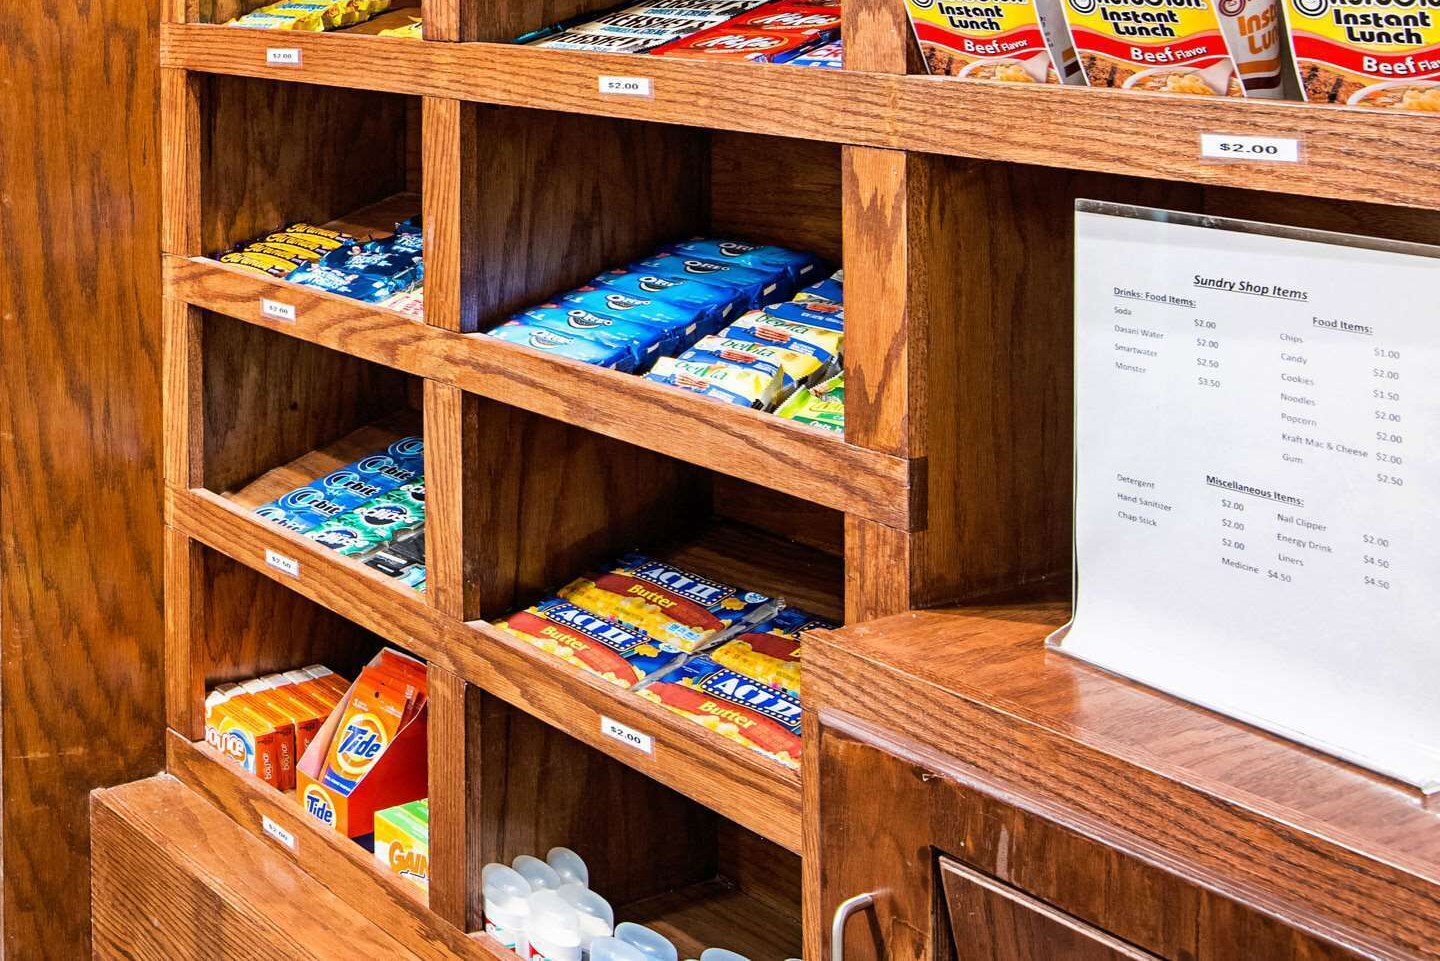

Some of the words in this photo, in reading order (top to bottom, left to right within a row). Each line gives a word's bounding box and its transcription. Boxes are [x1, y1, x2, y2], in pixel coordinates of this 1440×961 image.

[938, 3, 1003, 18] Instant
[1100, 6, 1179, 24] Instant
[1334, 8, 1431, 28] Instant
[949, 16, 1001, 31] Lunch
[1113, 22, 1175, 39] Lunch
[1346, 26, 1423, 44] Lunch
[963, 38, 1000, 54] Beef
[1000, 38, 1028, 52] Flavor
[1130, 46, 1174, 64] Beef
[1176, 45, 1208, 61] Flavor
[1362, 55, 1416, 75] Beef
[608, 81, 639, 91] $2.00
[1218, 142, 1279, 155] $2.00
[1193, 274, 1236, 291] Sundry
[1238, 280, 1269, 296] Shop
[1272, 285, 1309, 300] Items
[1113, 287, 1143, 298] Drinks:
[1145, 292, 1167, 302] Food
[1168, 296, 1197, 307] Items:
[1113, 306, 1132, 316] Soda
[1114, 324, 1139, 335] Dasani
[1140, 328, 1164, 339] Water
[1193, 318, 1216, 330] $2.00
[1312, 316, 1338, 328] Food
[1340, 321, 1374, 334] Items:
[1196, 338, 1219, 350] $2.00
[1279, 333, 1304, 344] Chips
[1114, 343, 1158, 357] Smartwater
[1374, 348, 1400, 360] $1.00
[1196, 357, 1219, 369] $2.50
[1280, 352, 1308, 365] Candy
[1115, 361, 1147, 374] Monster
[1372, 368, 1399, 380] $2.00
[1197, 377, 1220, 388] $3.50
[1281, 373, 1314, 386] Cookies
[1280, 393, 1316, 407] Noodles
[1372, 389, 1400, 402] $1.50
[1281, 413, 1318, 428] Popcorn
[1374, 410, 1401, 423] $2.00
[1376, 431, 1403, 444] $2.00
[1281, 433, 1303, 445] Kraft
[1305, 437, 1324, 449] Mac
[1335, 444, 1369, 458] Cheese
[1375, 452, 1402, 465] $2.00
[1282, 453, 1304, 464] Gum
[363, 456, 417, 481] Orbit
[328, 472, 381, 497] Orbit
[1116, 473, 1155, 489] Detergent
[1376, 473, 1403, 487] $2.50
[1206, 474, 1272, 499] Miscellaneous
[1273, 491, 1305, 507] Items:
[288, 488, 345, 516] Orbit
[1117, 492, 1138, 505] Hand
[1138, 497, 1172, 512] Sanitizer
[1221, 499, 1245, 512] $2.00
[1117, 510, 1137, 523] Chap
[1138, 515, 1158, 527] Stick
[1221, 518, 1245, 531] $2.00
[1277, 513, 1294, 525] Nail
[1295, 517, 1327, 533] Clipper
[1221, 537, 1245, 551] $2.00
[1277, 533, 1307, 549] Energy
[1308, 540, 1333, 553] Drink
[1362, 534, 1389, 548] $2.00
[1278, 553, 1305, 567] Liners
[1362, 555, 1390, 569] $4.50
[1221, 556, 1260, 574] Medicine
[1266, 569, 1292, 583] $4.50
[645, 566, 691, 587] ACT
[687, 581, 721, 599] II
[1363, 575, 1391, 590] $4.50
[627, 584, 678, 609] Butter
[558, 607, 606, 632] ACT
[601, 624, 635, 645] II
[540, 626, 591, 651] Butter
[714, 678, 774, 703] ACT
[699, 701, 758, 729] Butter
[338, 724, 383, 758] Tide
[610, 724, 641, 745] $2.00
[307, 794, 333, 823] Tide
